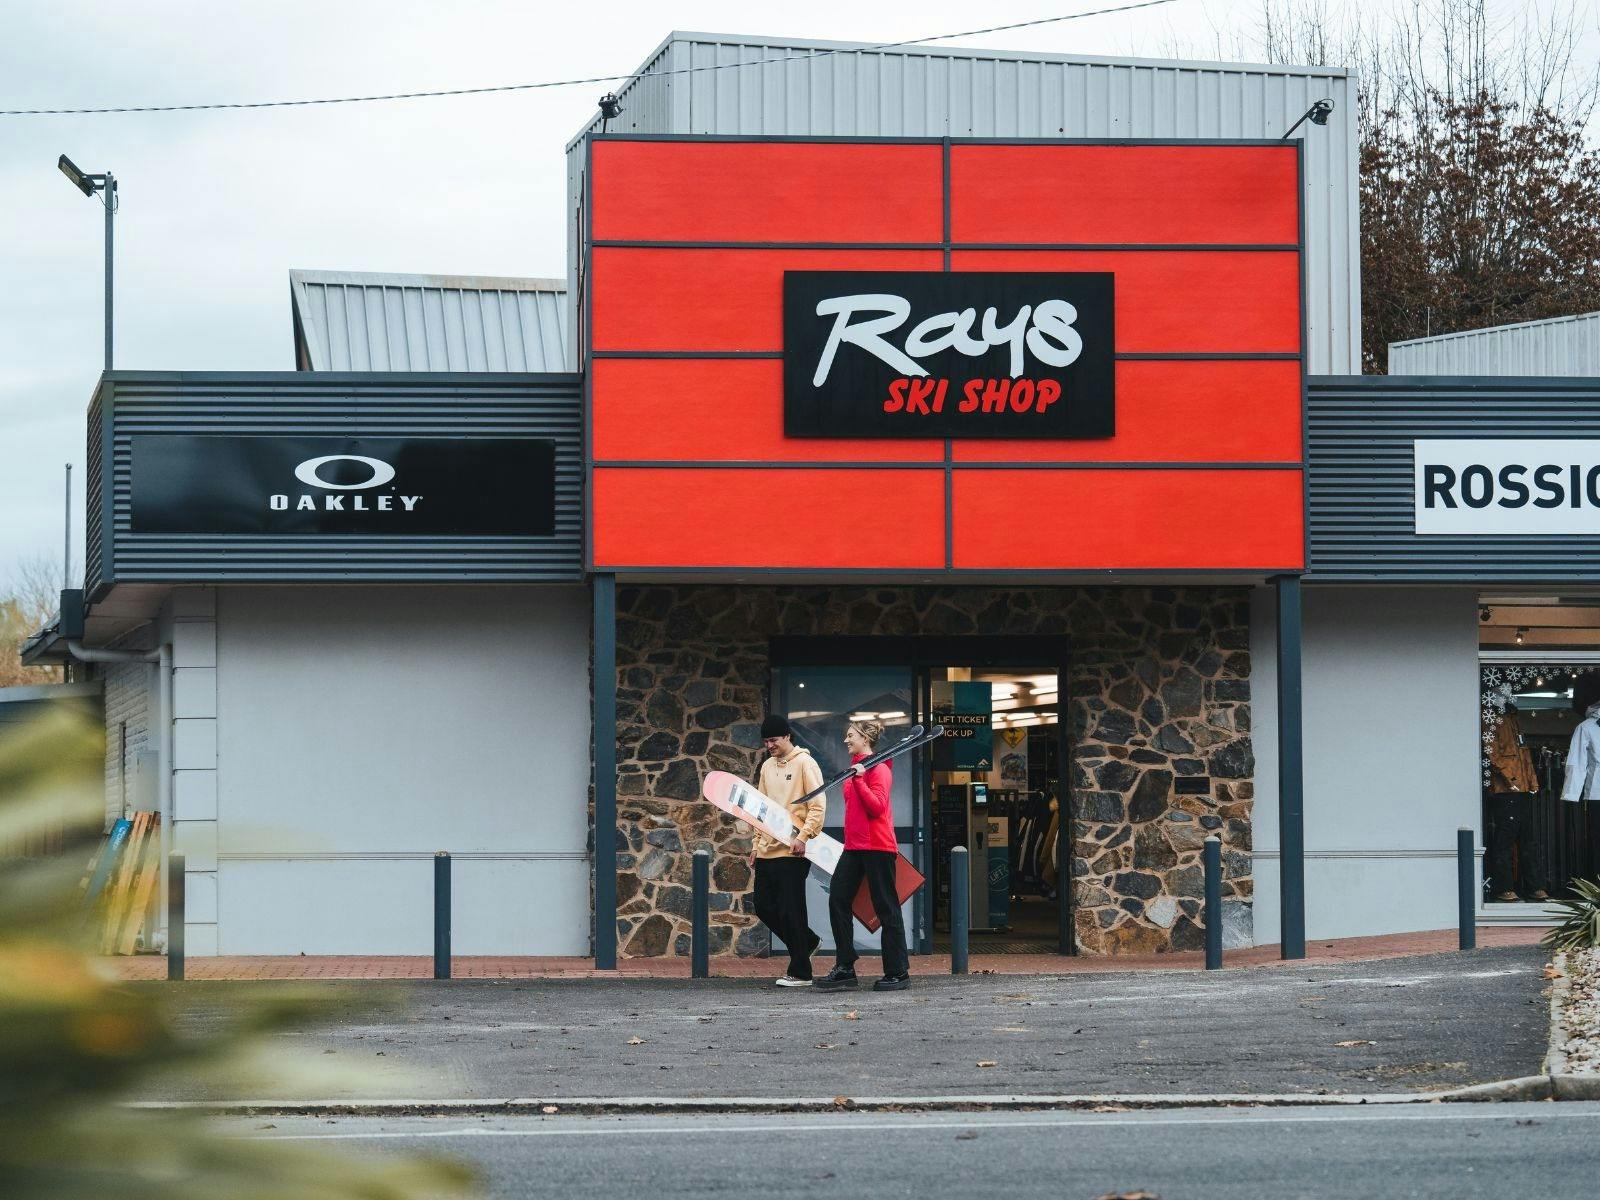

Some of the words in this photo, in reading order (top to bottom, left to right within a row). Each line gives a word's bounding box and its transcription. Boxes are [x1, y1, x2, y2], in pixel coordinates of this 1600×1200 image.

[813, 294, 1083, 387] Rays
[883, 379, 949, 415] SKI
[958, 379, 1062, 415] SHOP
[269, 494, 419, 511] OAKLEY
[938, 715, 955, 723] LIFT
[956, 715, 987, 723] TICKET
[942, 729, 959, 737] ICK
[960, 729, 973, 737] UP
